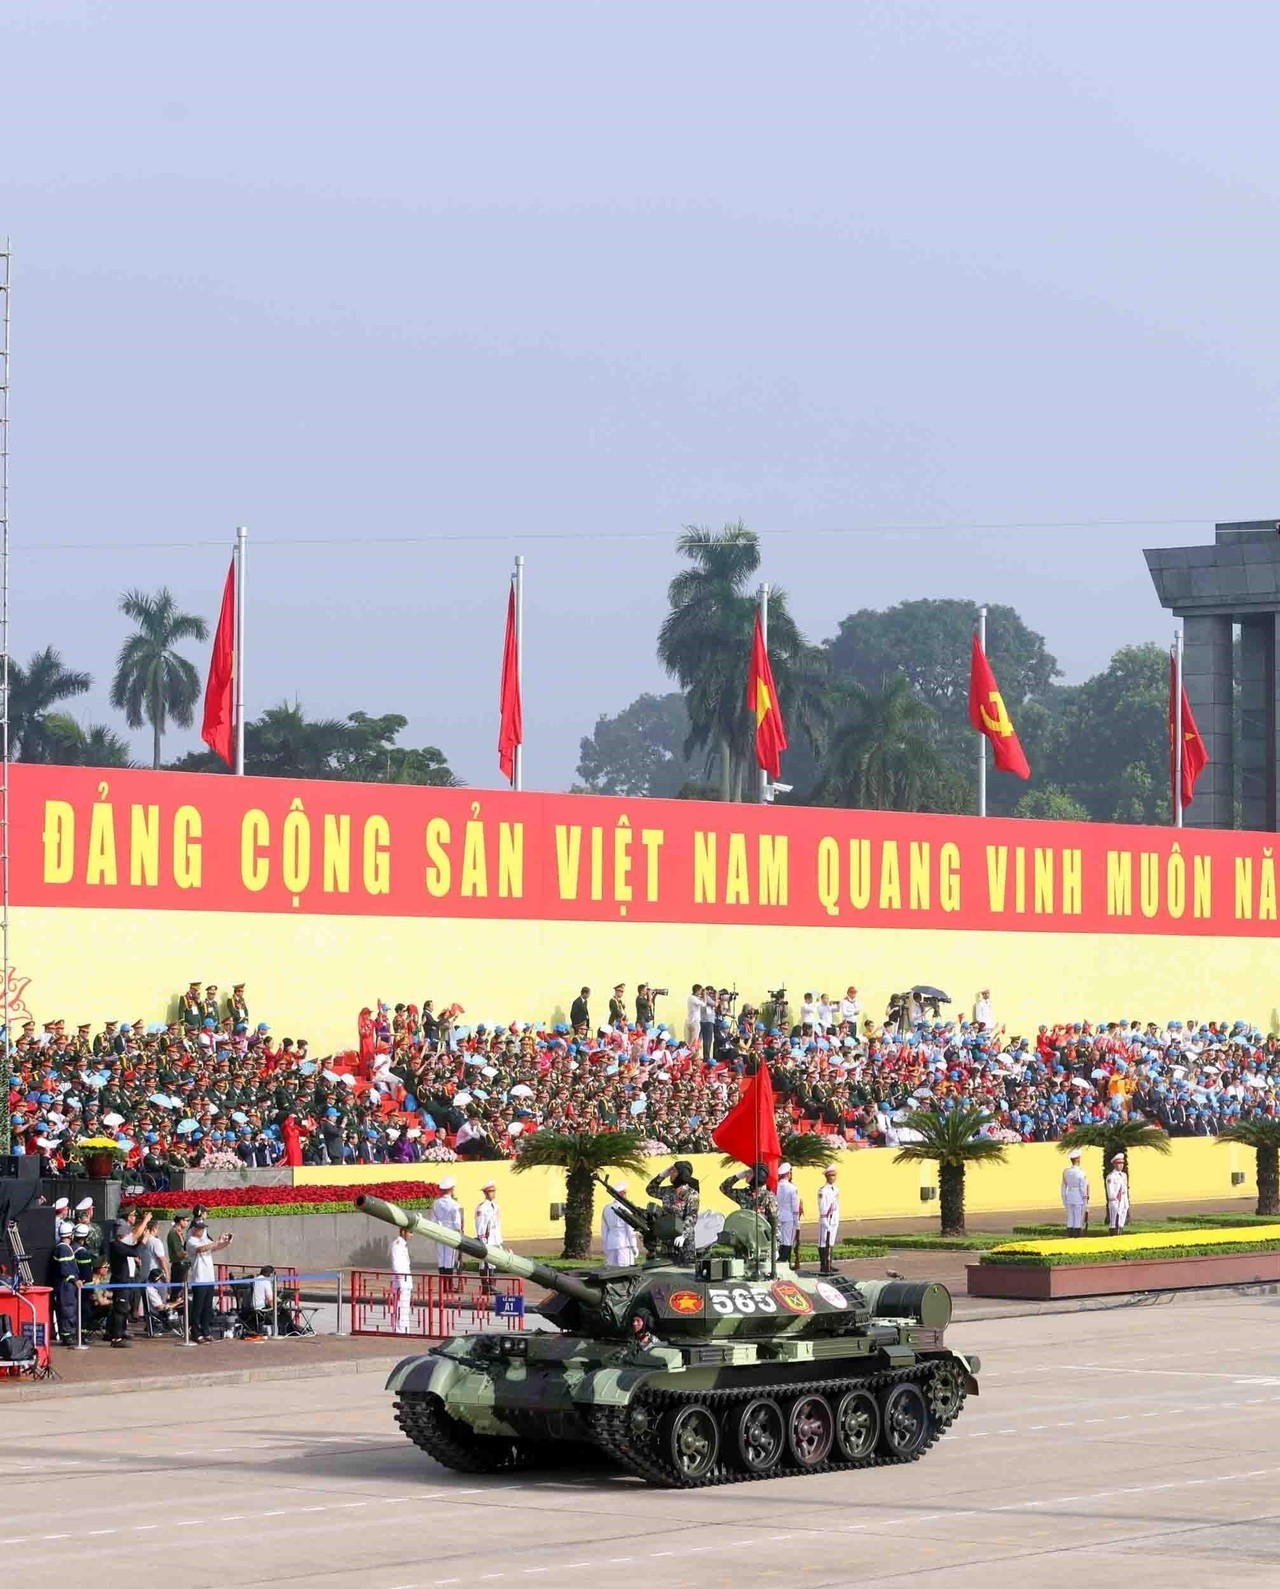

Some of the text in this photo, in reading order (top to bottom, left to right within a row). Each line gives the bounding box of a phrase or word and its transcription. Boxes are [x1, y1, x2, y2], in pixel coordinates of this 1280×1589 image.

[43, 782, 202, 889] ĐẢNG
[241, 797, 390, 908] CỘNG
[425, 801, 523, 898] SẢN
[555, 814, 664, 916] VIỆT
[694, 831, 788, 906] NAM
[818, 836, 961, 916] QUANG
[986, 845, 1082, 914] VINH
[1106, 841, 1212, 918] MUÔN
[504, 1302, 514, 1311] A1
[708, 1288, 777, 1313] 565
